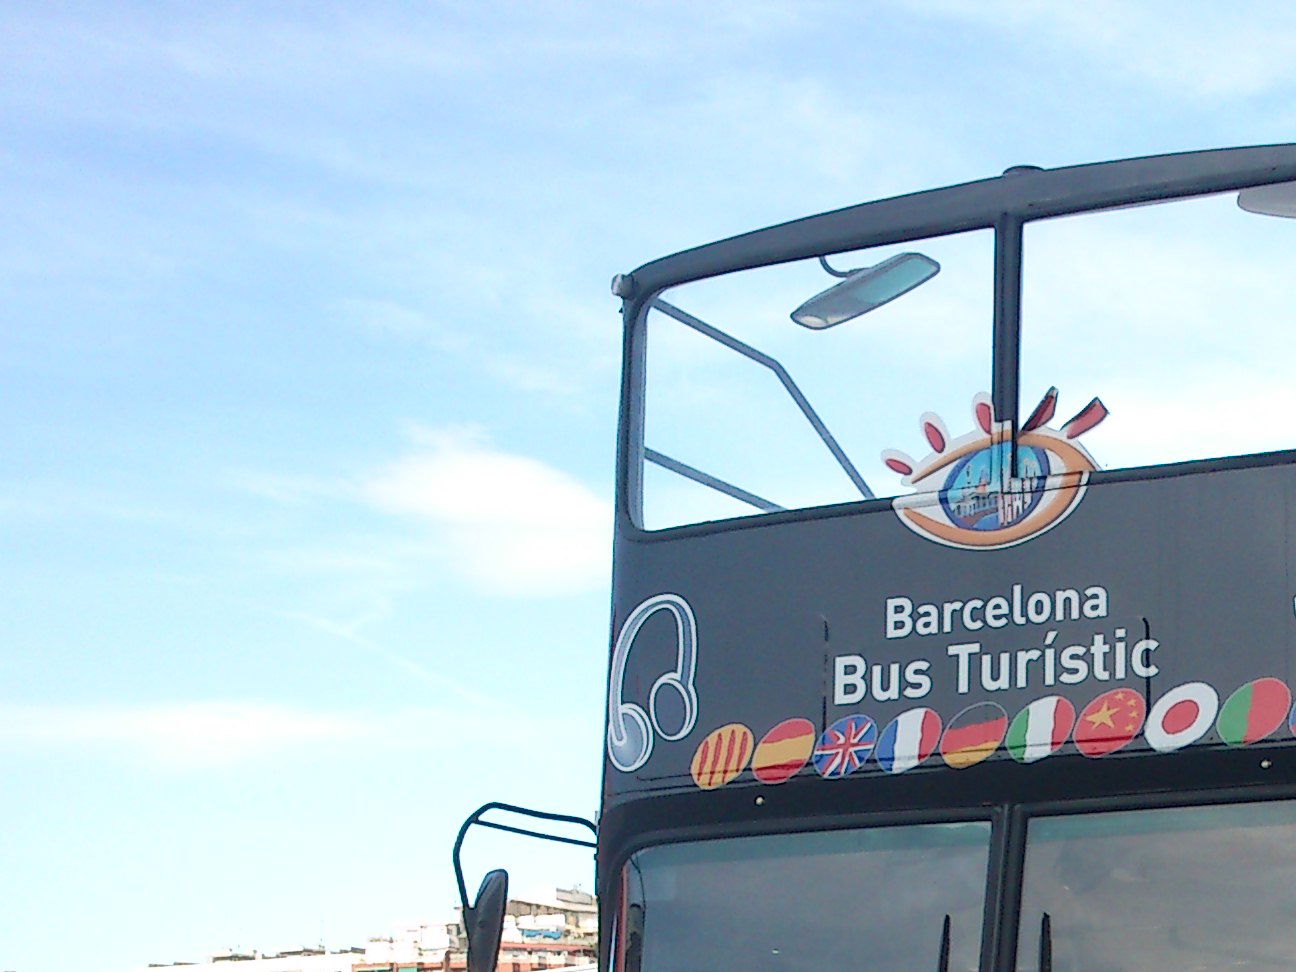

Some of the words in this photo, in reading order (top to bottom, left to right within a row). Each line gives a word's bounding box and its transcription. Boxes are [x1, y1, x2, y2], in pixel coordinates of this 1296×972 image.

[885, 584, 1109, 640] Barcelona
[833, 654, 932, 706] Bus
[946, 628, 1161, 695] Turístic
